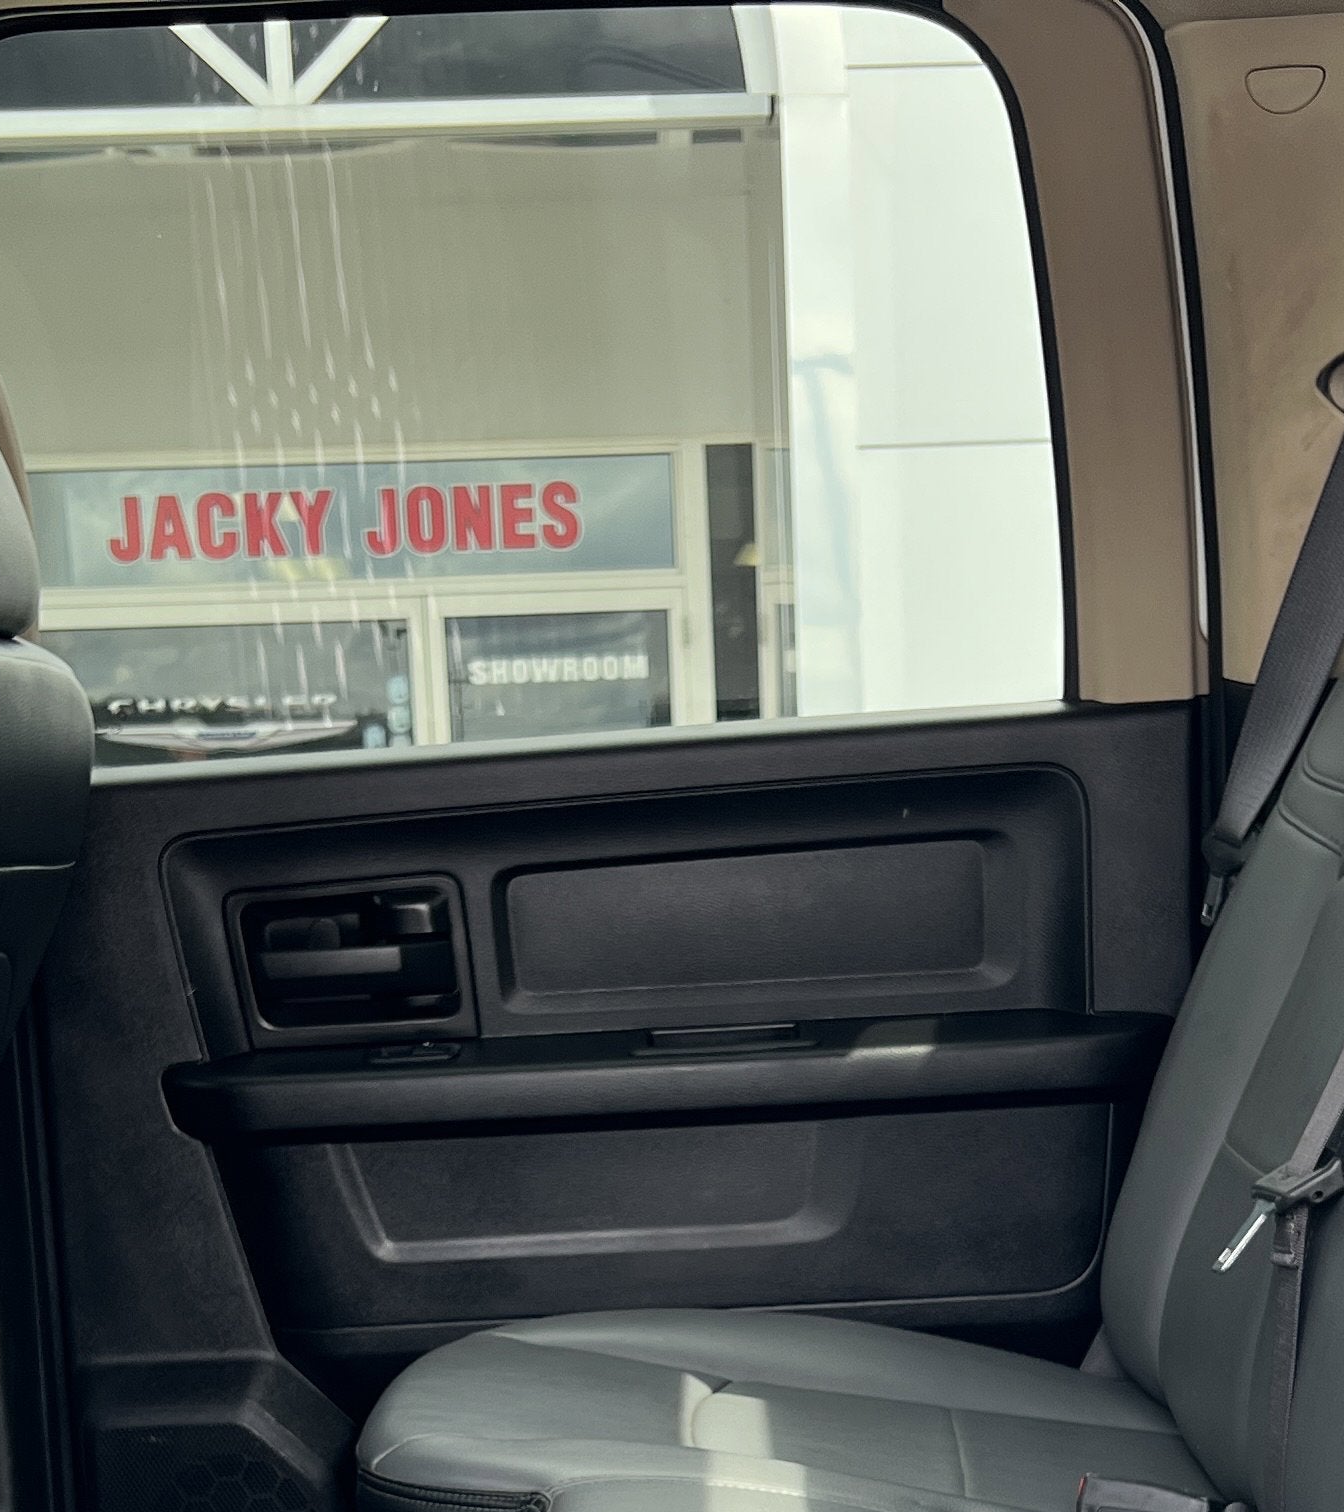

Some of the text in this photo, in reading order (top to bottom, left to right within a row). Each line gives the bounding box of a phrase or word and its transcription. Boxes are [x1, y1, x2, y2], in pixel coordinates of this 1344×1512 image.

[106, 480, 581, 564] JACKY JONES
[467, 655, 649, 685] SHOWROOM
